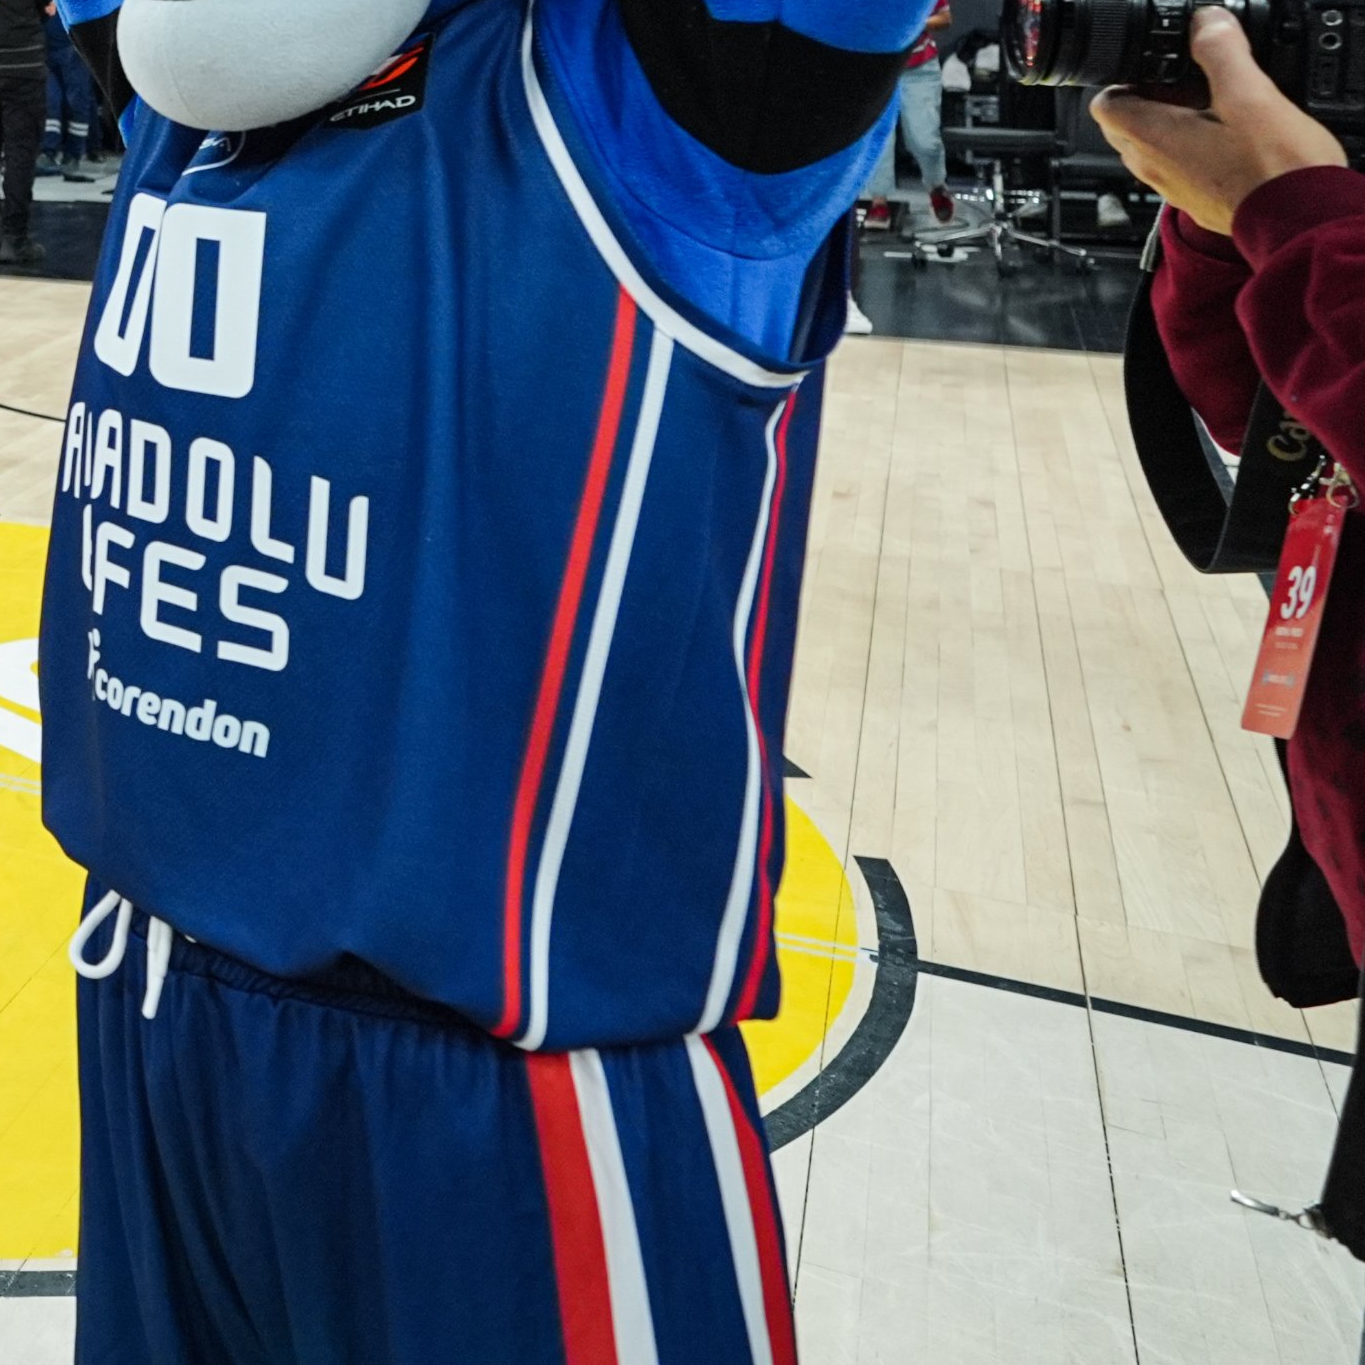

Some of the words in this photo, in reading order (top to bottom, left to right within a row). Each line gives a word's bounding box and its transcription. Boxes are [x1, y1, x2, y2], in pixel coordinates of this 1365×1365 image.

[94, 192, 267, 399] 00
[1280, 564, 1318, 620] 39
[94, 668, 271, 759] corendon
